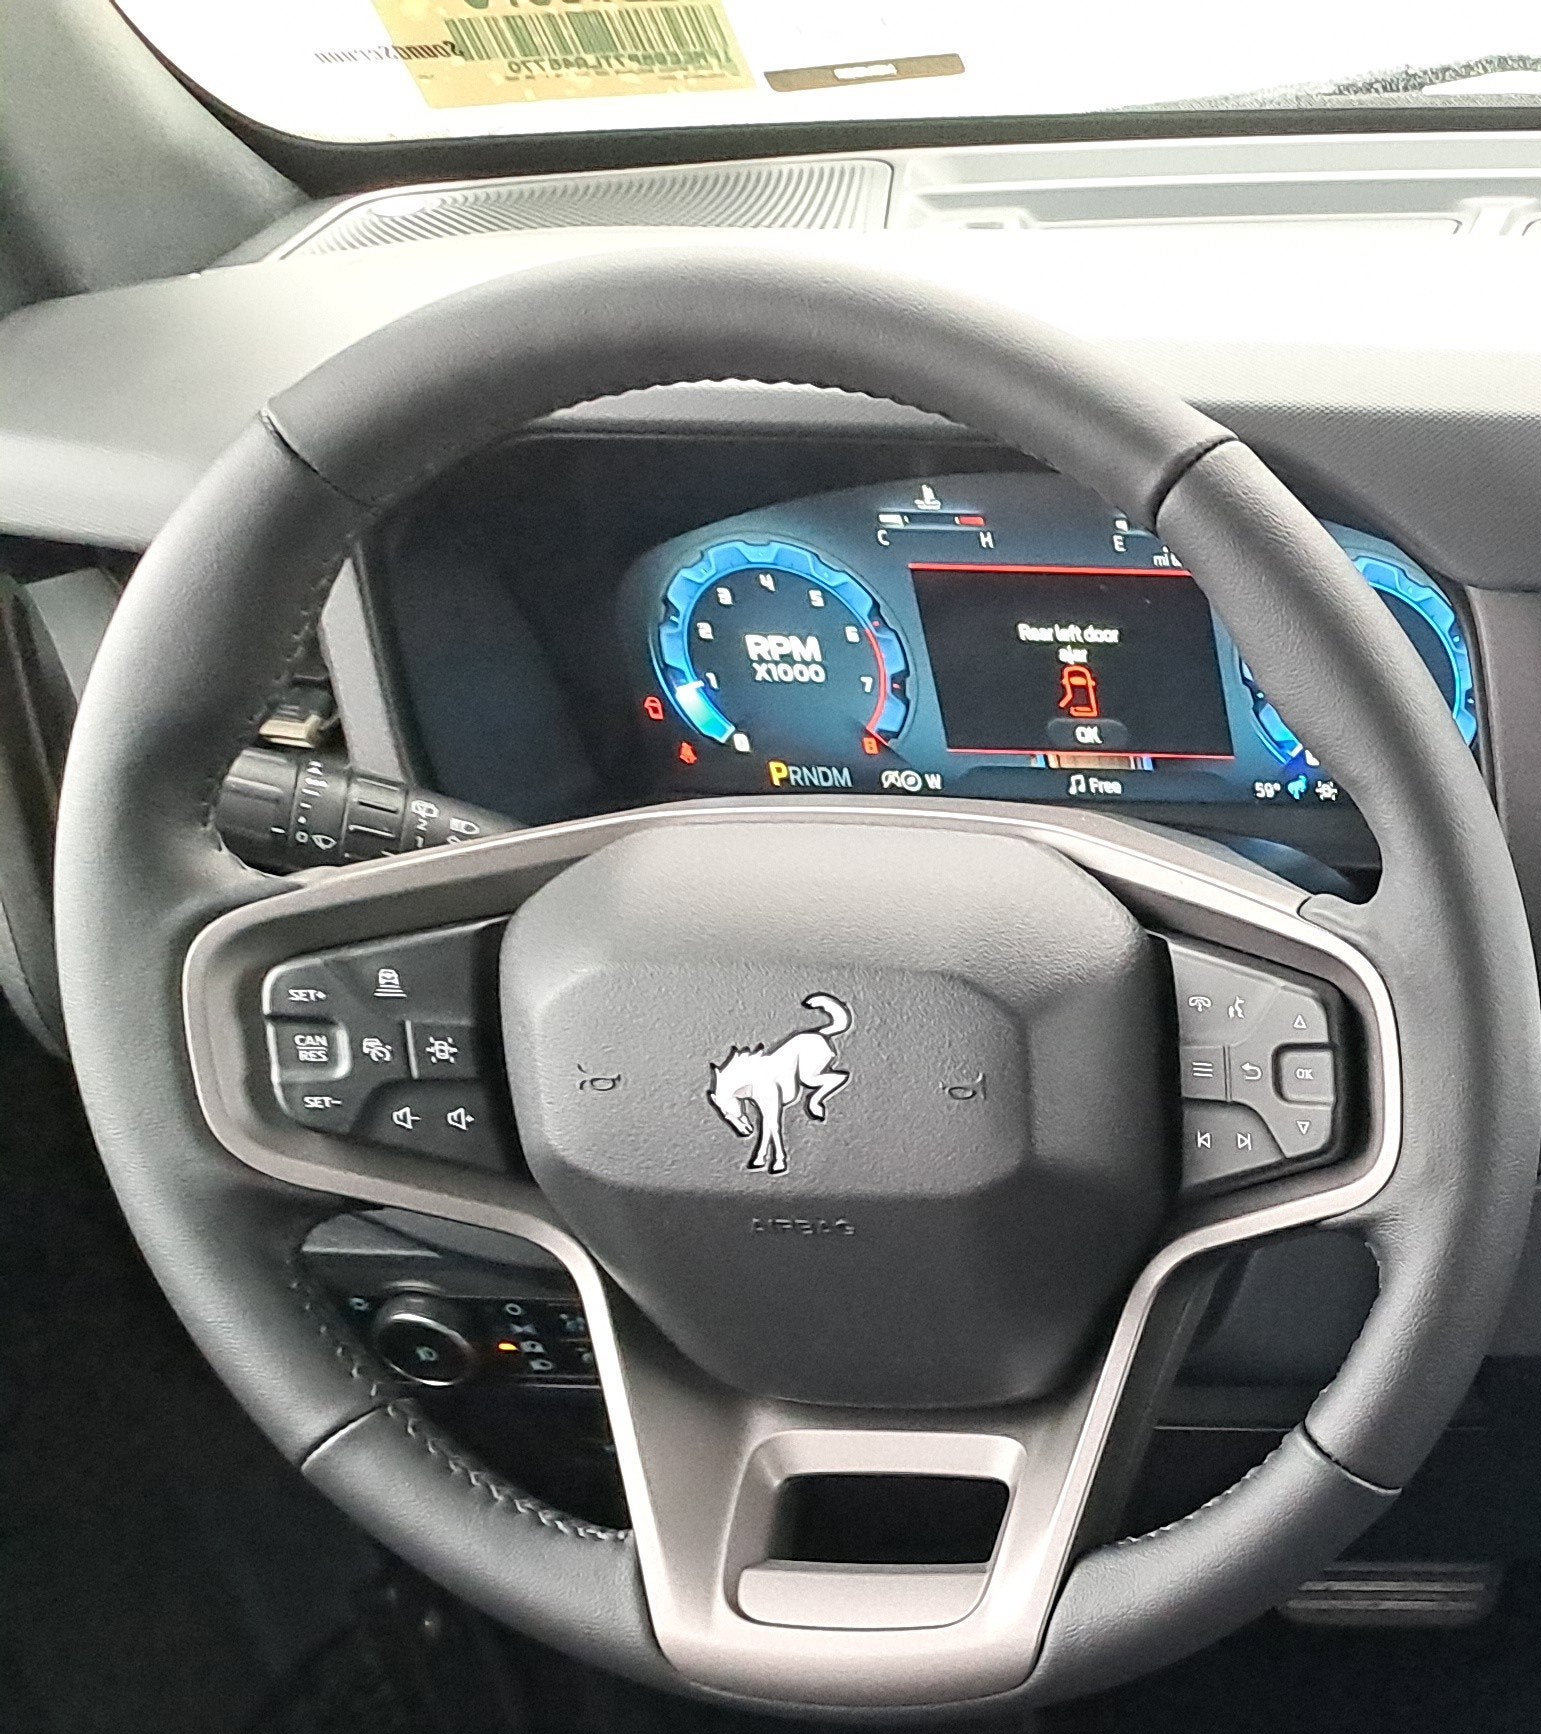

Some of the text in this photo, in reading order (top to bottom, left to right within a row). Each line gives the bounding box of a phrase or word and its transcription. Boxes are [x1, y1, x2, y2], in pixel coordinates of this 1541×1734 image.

[877, 529, 890, 546] C
[980, 531, 995, 549] H
[1113, 534, 1127, 552] E
[759, 574, 776, 592] 4
[716, 587, 733, 605] 3
[808, 589, 825, 607] 5
[697, 622, 714, 640] 2
[845, 626, 860, 643] 6
[1018, 623, 1119, 643] Rear left door
[745, 634, 823, 662] RPM
[1059, 644, 1087, 665] ajar
[705, 672, 719, 689] 1
[752, 663, 825, 683] X1000
[861, 677, 874, 693] 7
[1075, 726, 1102, 744] OK
[862, 736, 880, 755] 8
[925, 773, 942, 790] W
[294, 1034, 329, 1046] CAN
[299, 1050, 329, 1062] RES
[1296, 1069, 1314, 1081] OK
